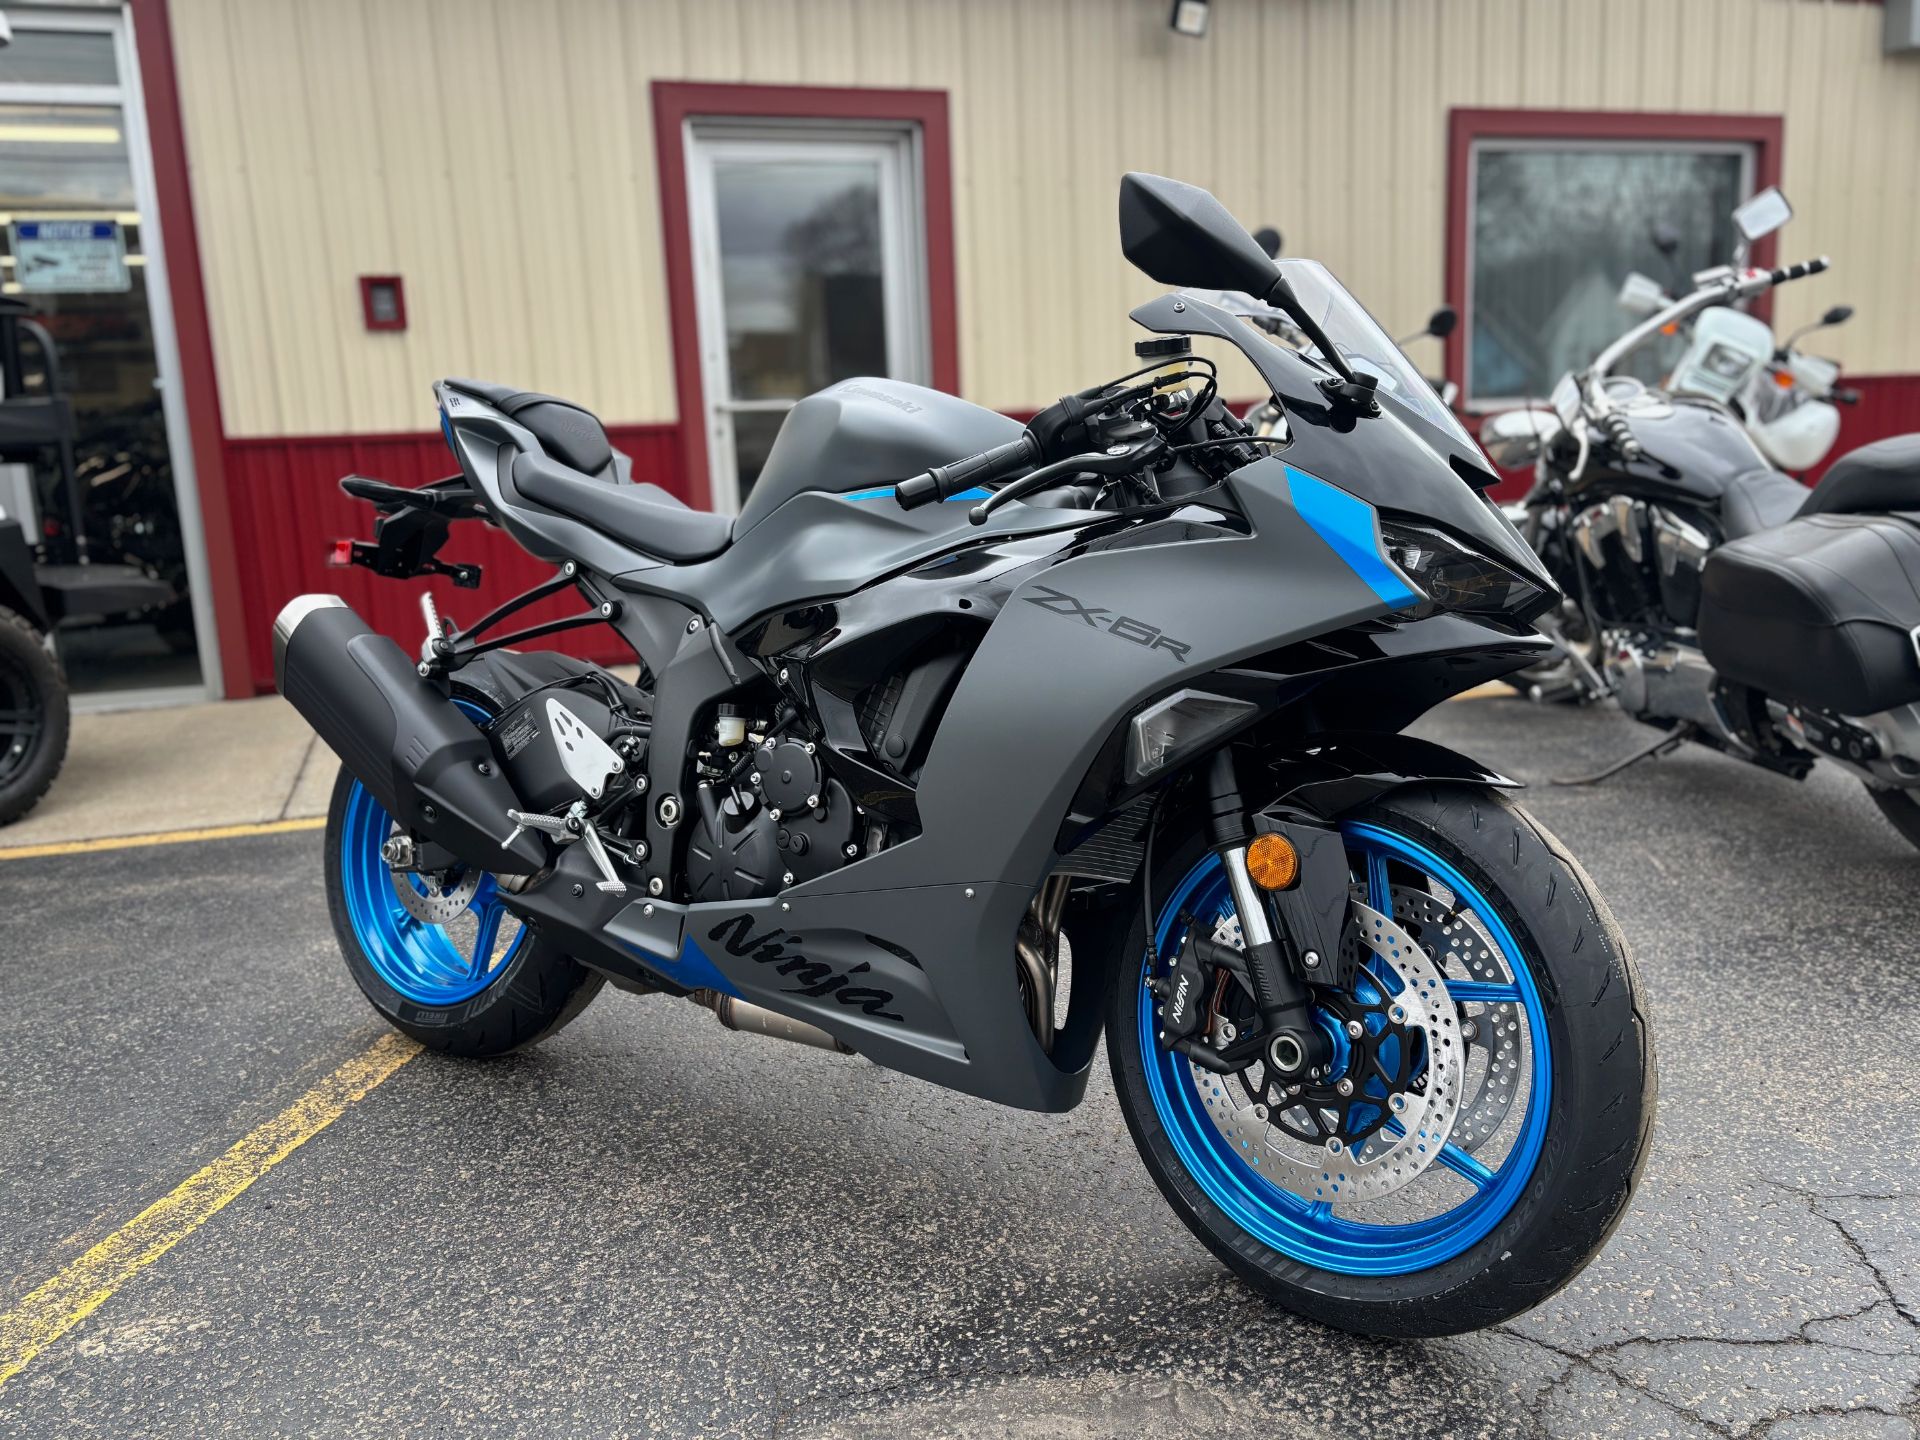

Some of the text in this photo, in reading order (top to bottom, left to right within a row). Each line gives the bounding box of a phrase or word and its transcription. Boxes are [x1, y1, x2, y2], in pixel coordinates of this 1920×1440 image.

[838, 384, 923, 413] Kawasaki
[1022, 586, 1192, 663] ZX-6R
[708, 913, 904, 1022] Ninja
[1172, 974, 1189, 1024] NISSIN
